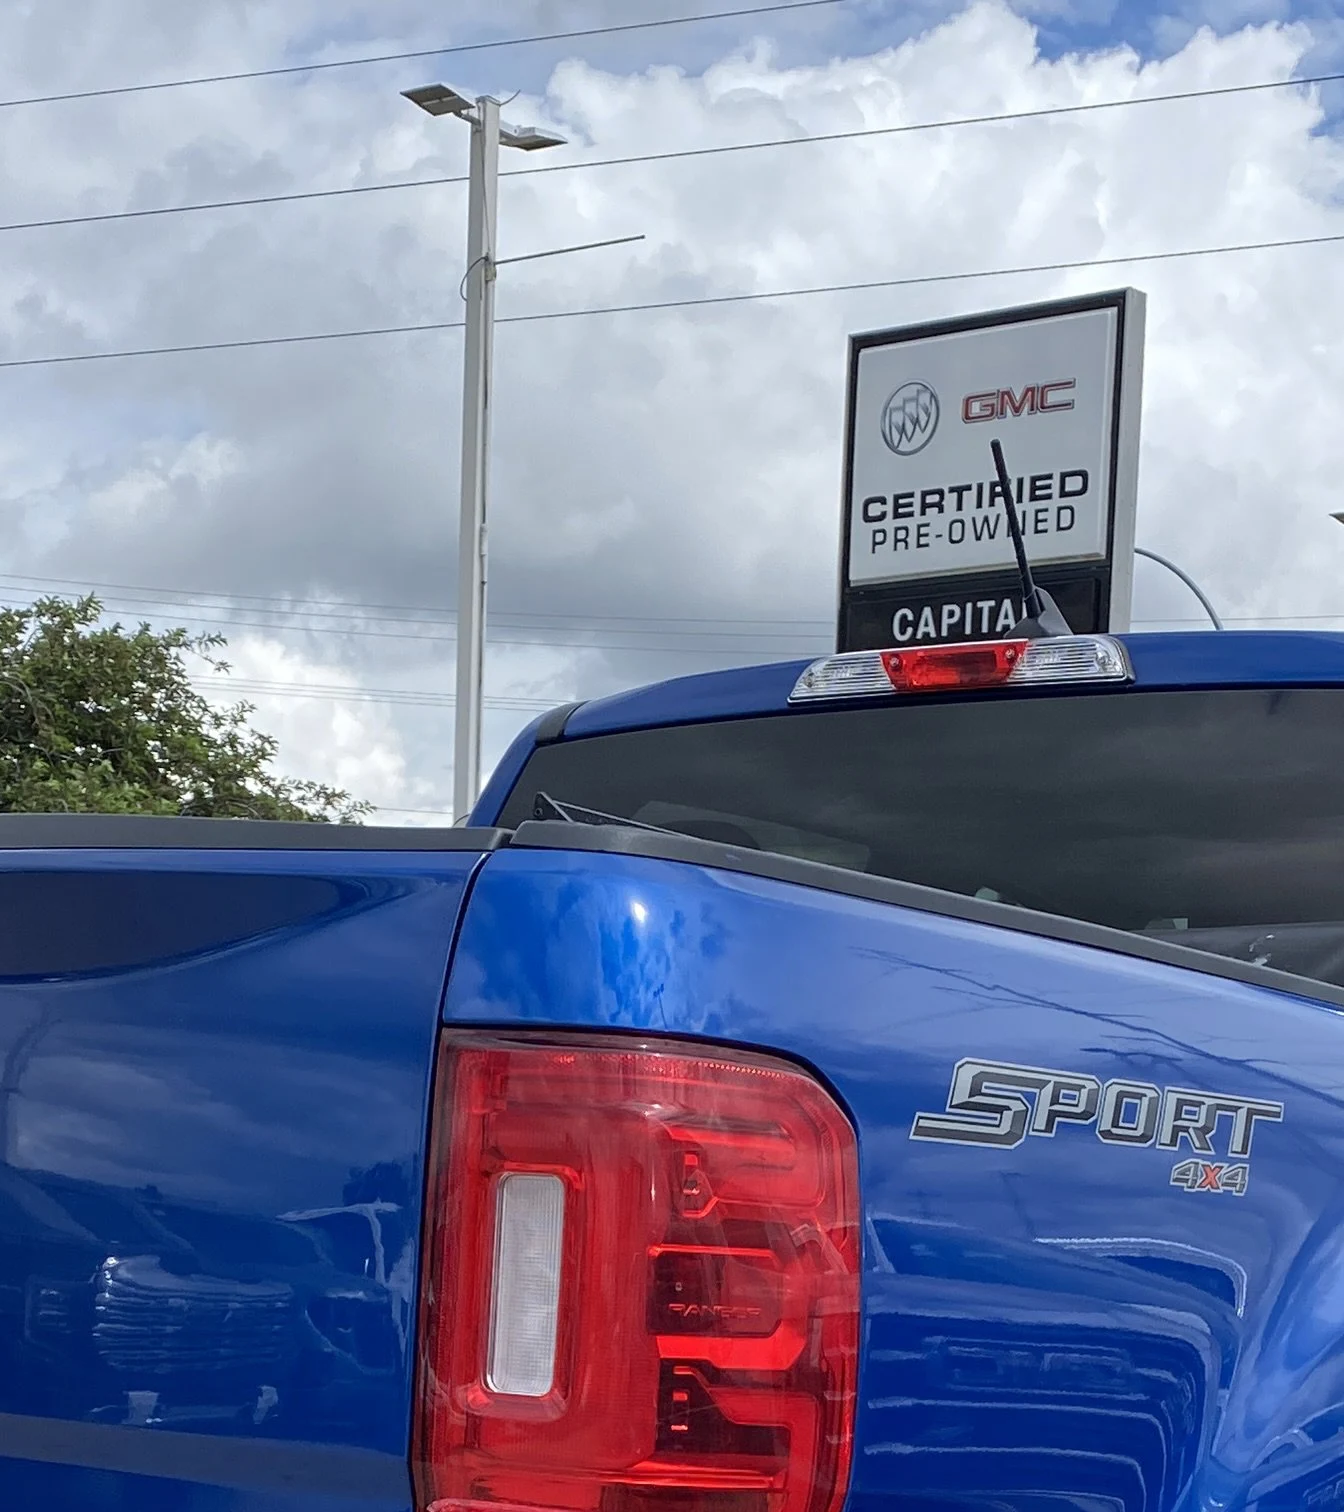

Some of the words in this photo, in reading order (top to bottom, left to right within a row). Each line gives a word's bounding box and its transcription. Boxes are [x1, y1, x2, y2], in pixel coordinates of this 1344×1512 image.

[961, 377, 1076, 424] GMC
[862, 469, 1089, 524] CERTIFIED
[871, 505, 1075, 554] PRE-OWNED
[892, 598, 1027, 642] CAPITA
[908, 1056, 1285, 1159] SPORT
